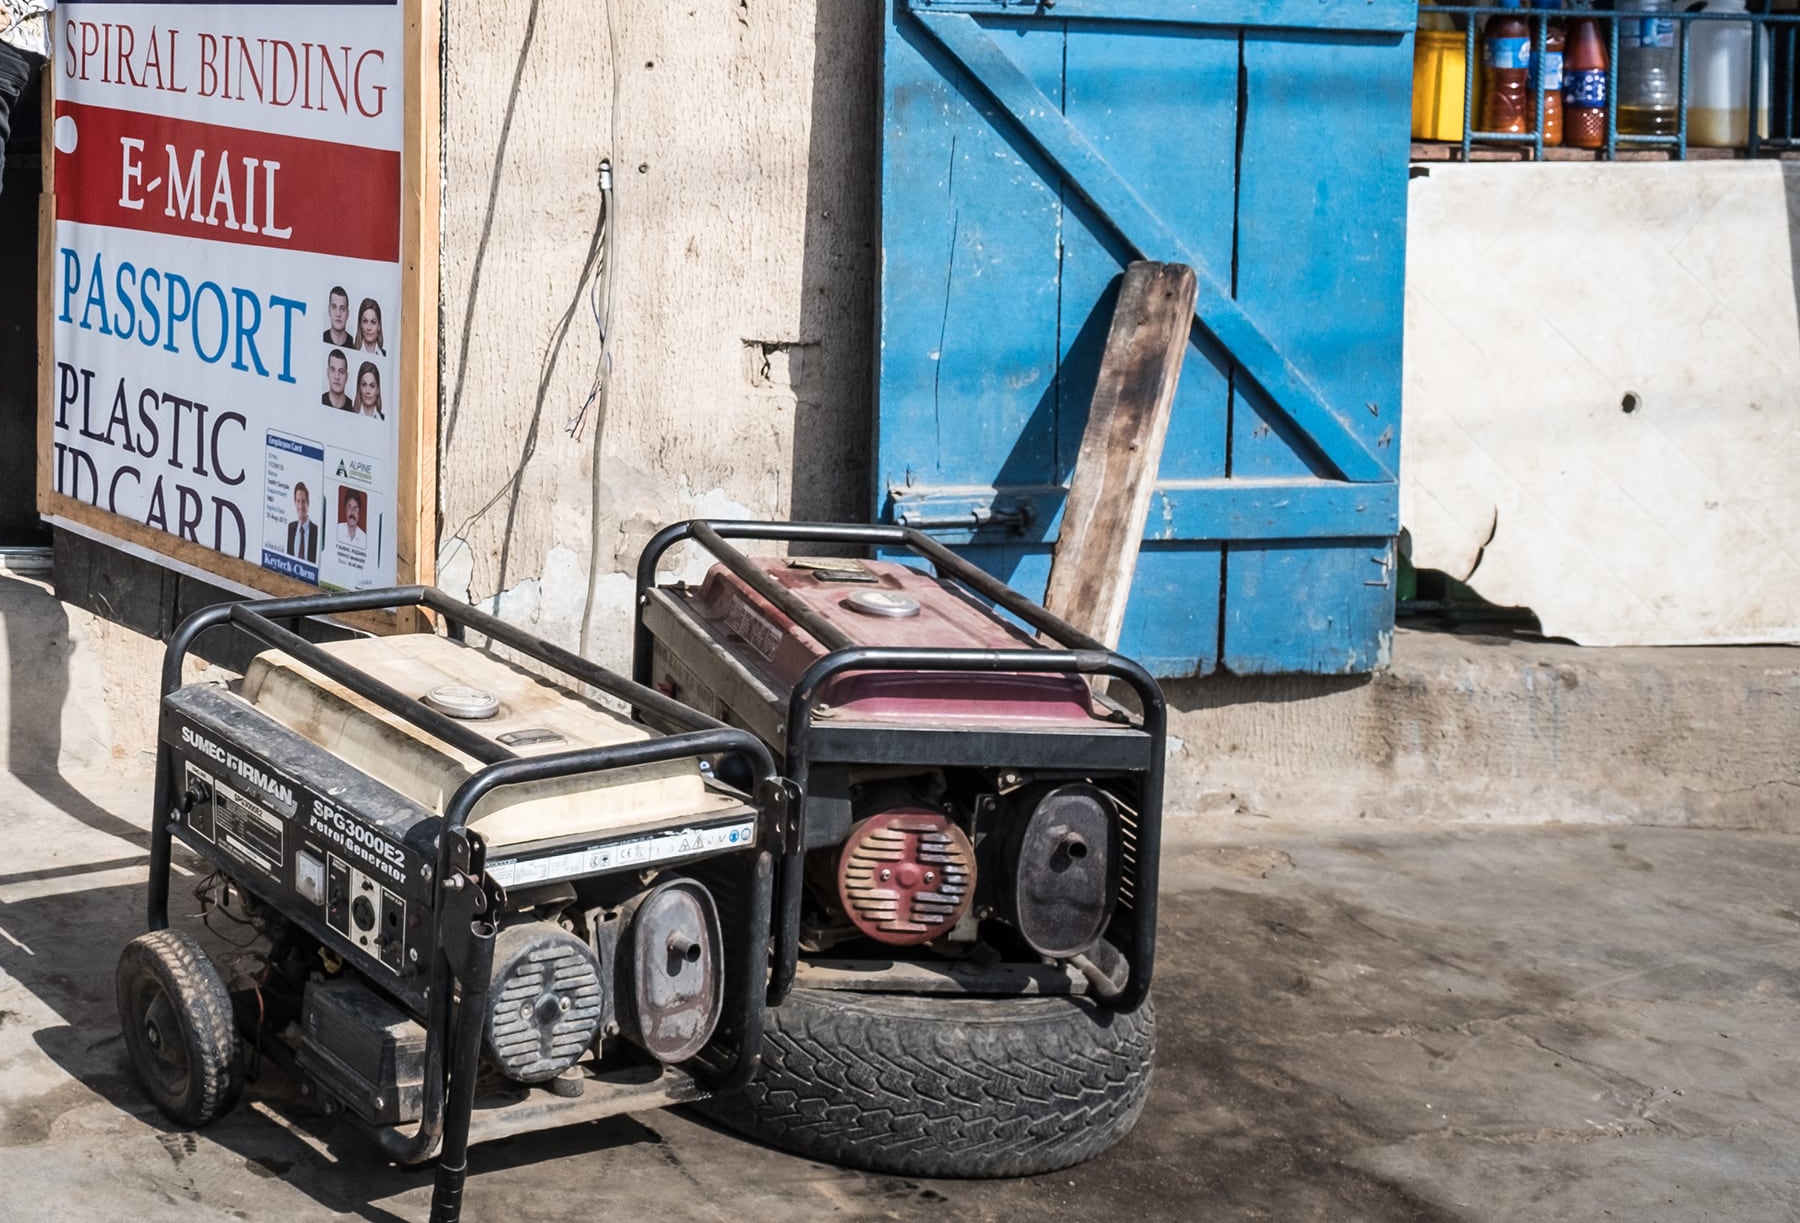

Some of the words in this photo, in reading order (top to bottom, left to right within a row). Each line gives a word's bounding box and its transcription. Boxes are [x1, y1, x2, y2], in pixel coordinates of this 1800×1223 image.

[65, 19, 188, 94] SPIRAL
[197, 32, 387, 118] BINDING
[118, 135, 293, 241] E-MAIL
[58, 247, 307, 384] PASSPORT
[55, 361, 247, 486] PLASTIC
[350, 460, 373, 475] ALPINE
[54, 442, 99, 506] ID
[108, 464, 246, 560] CARD
[181, 726, 226, 764] SUMEC
[309, 815, 345, 846] Petrol
[345, 838, 407, 884] Generator
[312, 799, 406, 869] SPG3000E2
